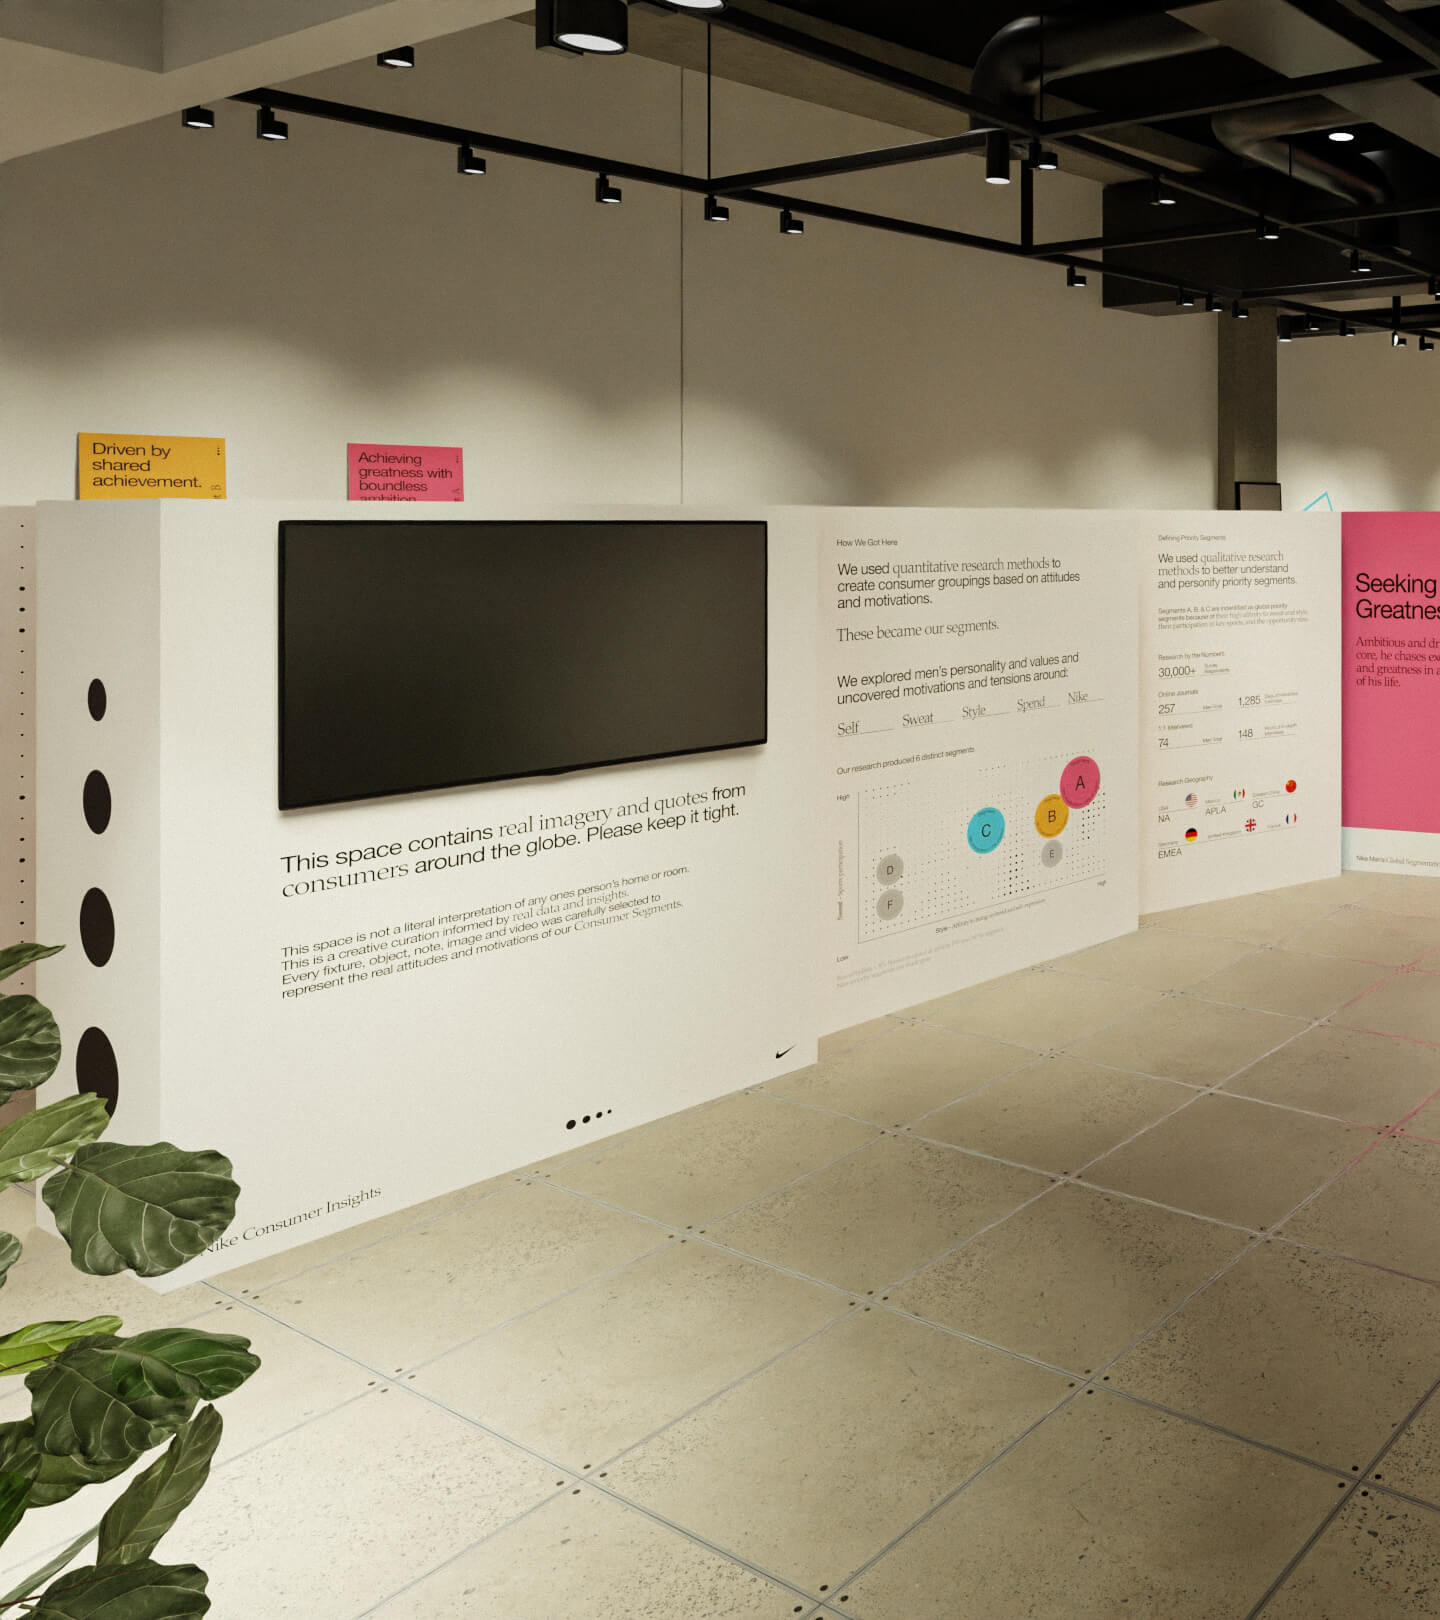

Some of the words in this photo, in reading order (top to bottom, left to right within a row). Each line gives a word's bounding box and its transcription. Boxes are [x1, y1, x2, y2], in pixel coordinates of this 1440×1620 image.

[93, 442, 145, 456] Driven
[147, 444, 171, 461] by
[92, 459, 150, 471] shared
[358, 451, 422, 467] Achieving
[358, 467, 424, 479] greatness
[427, 468, 452, 479] with
[93, 474, 202, 488] achievement.
[360, 480, 428, 492] boundless
[836, 539, 853, 547] How
[854, 538, 866, 546] We
[867, 538, 880, 546] Got
[1158, 553, 1174, 563] We
[1176, 553, 1198, 563] used
[1200, 552, 1247, 564] qualitative
[1249, 551, 1283, 561] research
[837, 563, 858, 576] We
[861, 562, 890, 575] used
[893, 560, 959, 577] quantitative
[962, 558, 1004, 572] research
[1007, 557, 1050, 570] methods
[1052, 558, 1061, 568] to
[1158, 564, 1200, 576] methods
[1201, 564, 1211, 575] to
[1213, 565, 1238, 574] better
[1240, 564, 1288, 574] understand
[837, 579, 875, 592] create
[878, 577, 936, 590] consumer
[938, 575, 990, 591] groupings
[993, 573, 1024, 585] based
[1026, 575, 1038, 583] on
[1041, 571, 1080, 583] attitudes
[1356, 573, 1437, 598] Seeking
[838, 595, 860, 608] and
[865, 593, 932, 607] motivations.
[836, 627, 874, 642] These
[876, 625, 922, 639] became
[925, 625, 944, 635] our
[946, 619, 999, 636] segments.
[1356, 636, 1406, 648] Ambitious
[1407, 637, 1426, 648] and
[837, 675, 858, 688] We
[861, 669, 911, 687] explored
[915, 666, 948, 680] men's
[950, 660, 1006, 679] personality
[1008, 657, 1027, 670] and
[1030, 656, 1059, 667] values
[1061, 651, 1079, 664] and
[1158, 666, 1196, 678] 30,000+
[837, 685, 900, 704] uncovered
[903, 680, 965, 696] motivations
[968, 676, 988, 689] and
[990, 673, 1031, 686] tensions
[1033, 667, 1068, 681] around:
[1239, 696, 1261, 707] 1,285
[838, 722, 860, 736] Self
[902, 712, 934, 727] Sweat
[962, 704, 986, 720] Style
[1016, 696, 1046, 712] Spend
[1068, 691, 1088, 704] Nike
[1158, 704, 1176, 714] 257
[1158, 738, 1169, 748] 74
[1075, 776, 1086, 791] A
[1048, 810, 1056, 822] B
[1205, 806, 1226, 816] APLA
[280, 852, 329, 873] This
[336, 843, 402, 867] space
[408, 827, 493, 852] contains
[499, 817, 532, 837] real
[540, 808, 612, 830] imagery
[617, 798, 649, 817] and
[654, 792, 710, 815] quotes
[712, 786, 745, 801] from
[981, 824, 992, 838] C
[283, 864, 408, 897] consumers
[415, 847, 485, 873] around
[490, 844, 521, 859] the
[526, 834, 580, 857] globe.
[587, 823, 643, 842] Please
[648, 815, 686, 831] keep
[691, 810, 699, 823] it
[703, 803, 739, 823] tight.
[1158, 848, 1182, 859] EMEA
[281, 945, 310, 958] This
[313, 937, 353, 952] space
[356, 932, 367, 942] is
[370, 927, 390, 939] not
[404, 917, 435, 933] literal
[438, 904, 511, 925] interpretation
[515, 898, 525, 909] of
[528, 896, 547, 909] any
[549, 890, 575, 902] ones
[578, 880, 620, 898] person's
[622, 875, 649, 886] home
[663, 867, 690, 878] room.
[242, 1208, 322, 1240] Consumer
[327, 1188, 381, 1213] Insights
